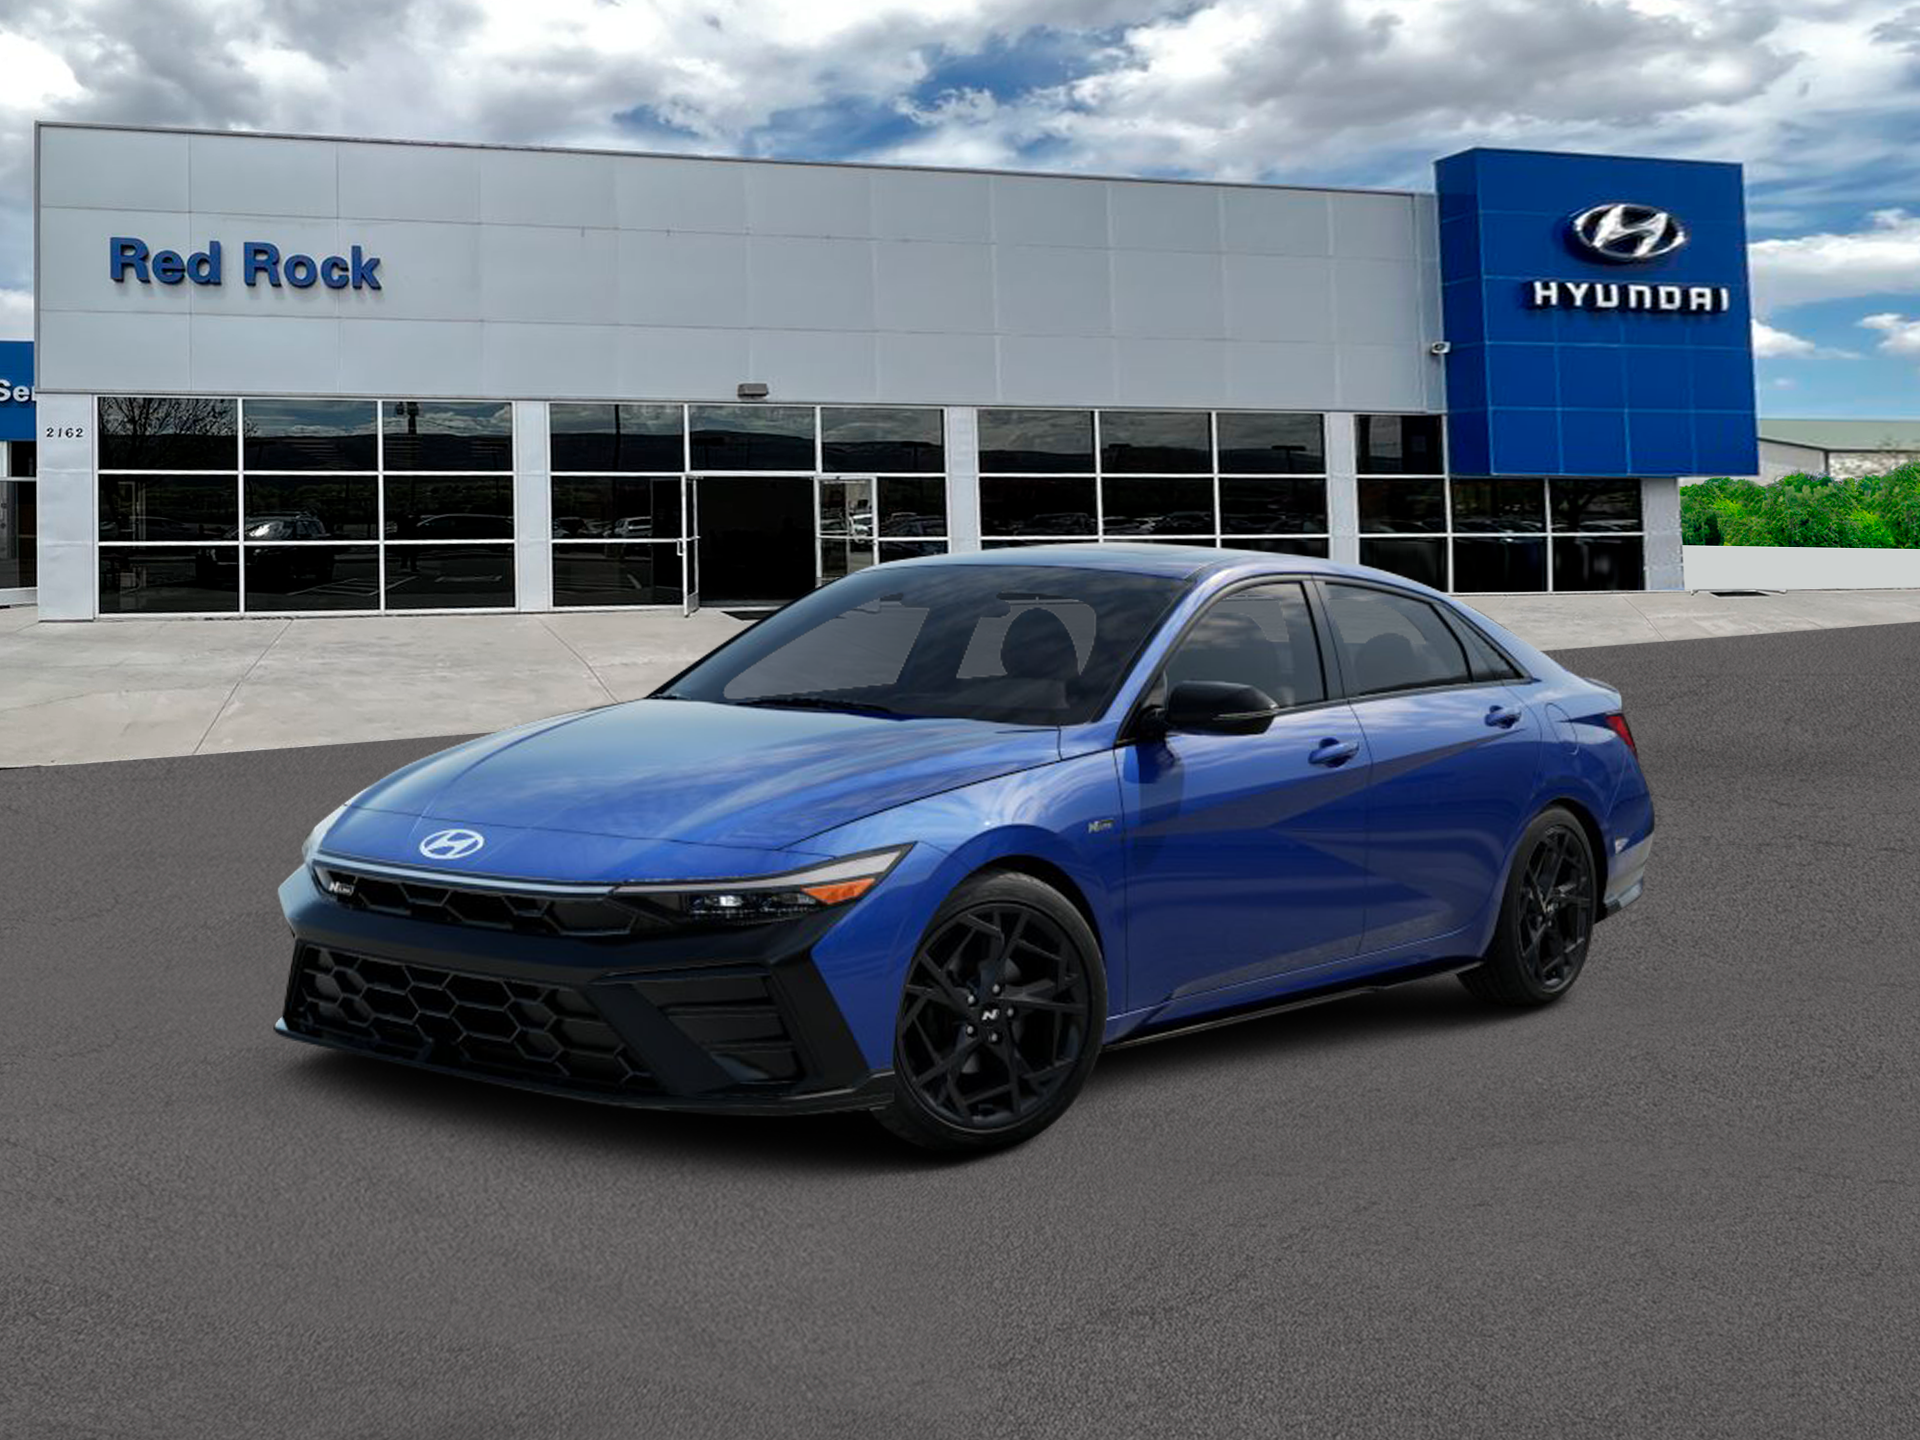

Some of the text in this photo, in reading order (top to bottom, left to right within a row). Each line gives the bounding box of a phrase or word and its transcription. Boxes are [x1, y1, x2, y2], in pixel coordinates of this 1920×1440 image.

[109, 236, 382, 291] Red Rock
[1533, 280, 1730, 312] HYUNDAI
[46, 427, 84, 438] 2162
